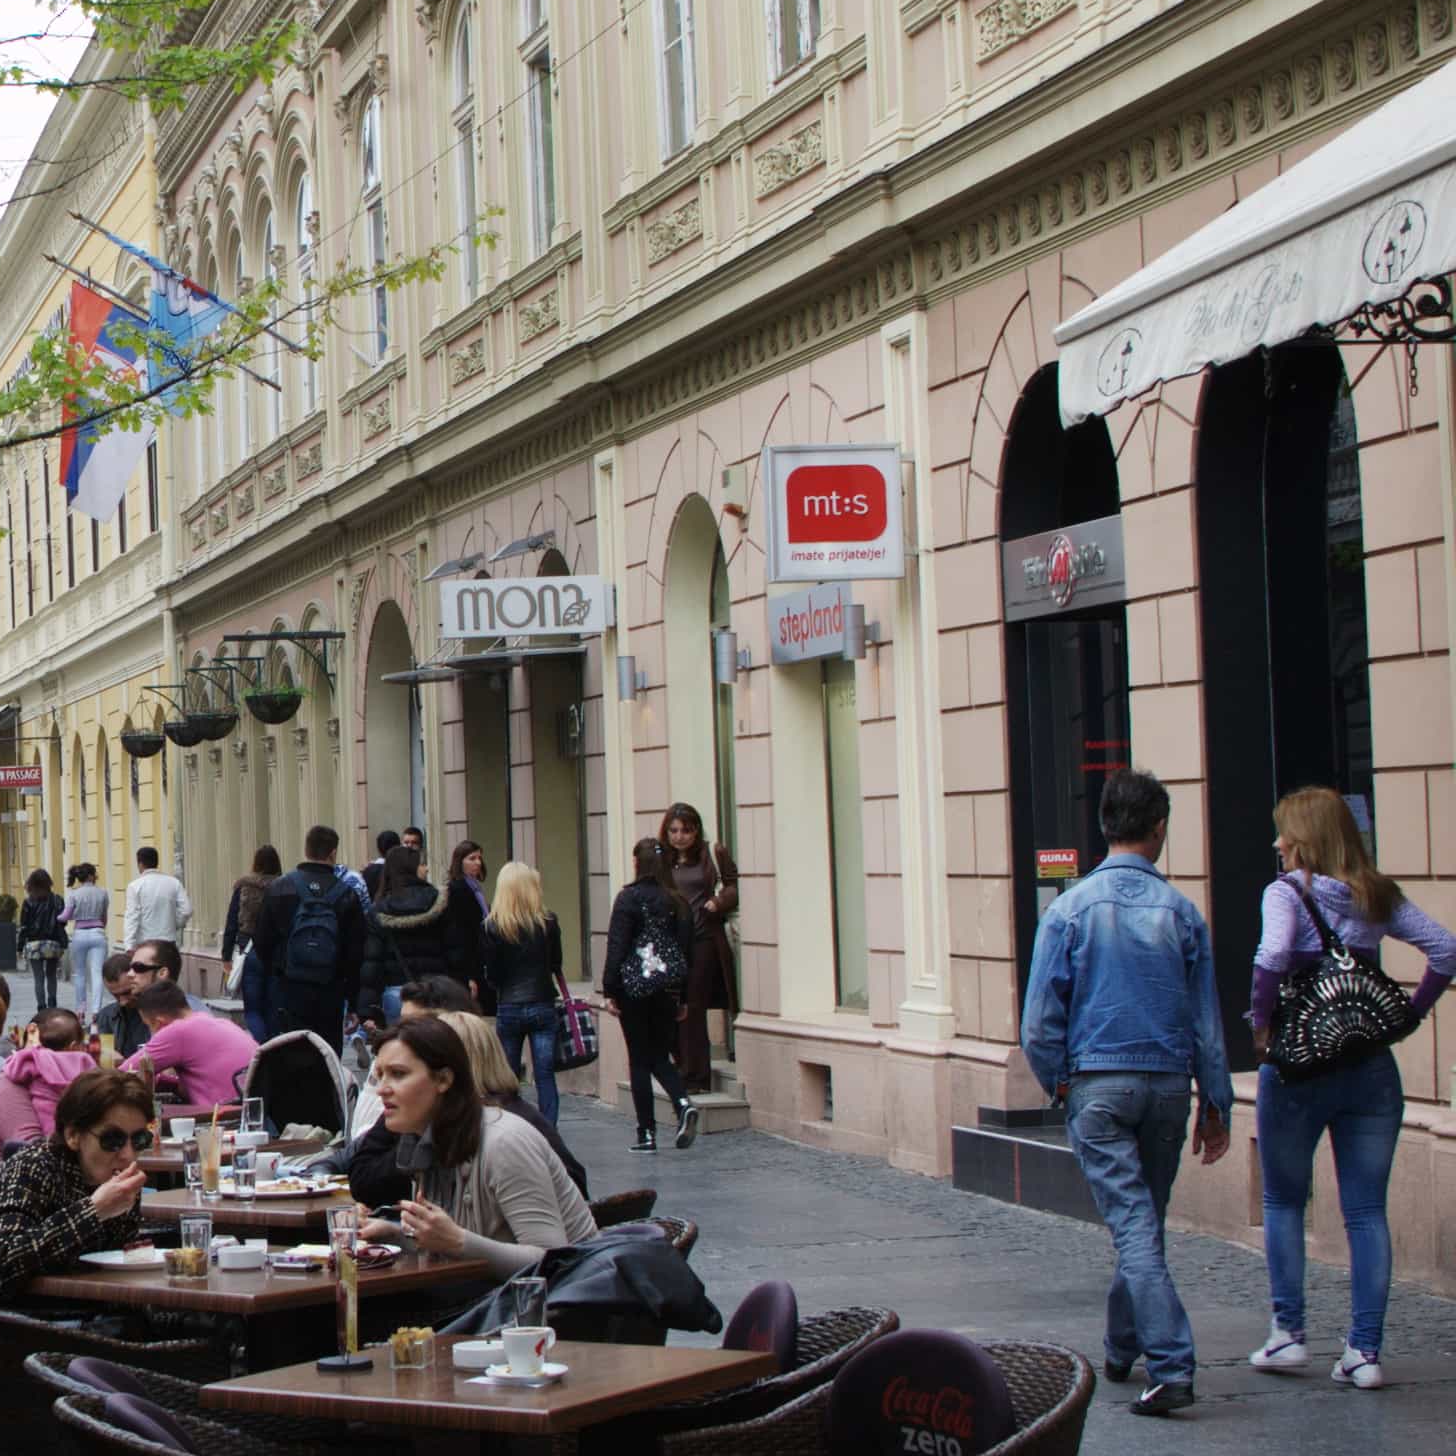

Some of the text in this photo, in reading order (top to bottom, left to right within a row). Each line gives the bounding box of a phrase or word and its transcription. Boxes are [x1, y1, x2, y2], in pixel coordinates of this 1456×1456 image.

[803, 490, 869, 517] mt:s
[791, 546, 887, 563] imate prijatelje!
[779, 587, 844, 653] stepland
[6, 768, 41, 781] PASSAGE
[1039, 853, 1074, 863] GURAJ
